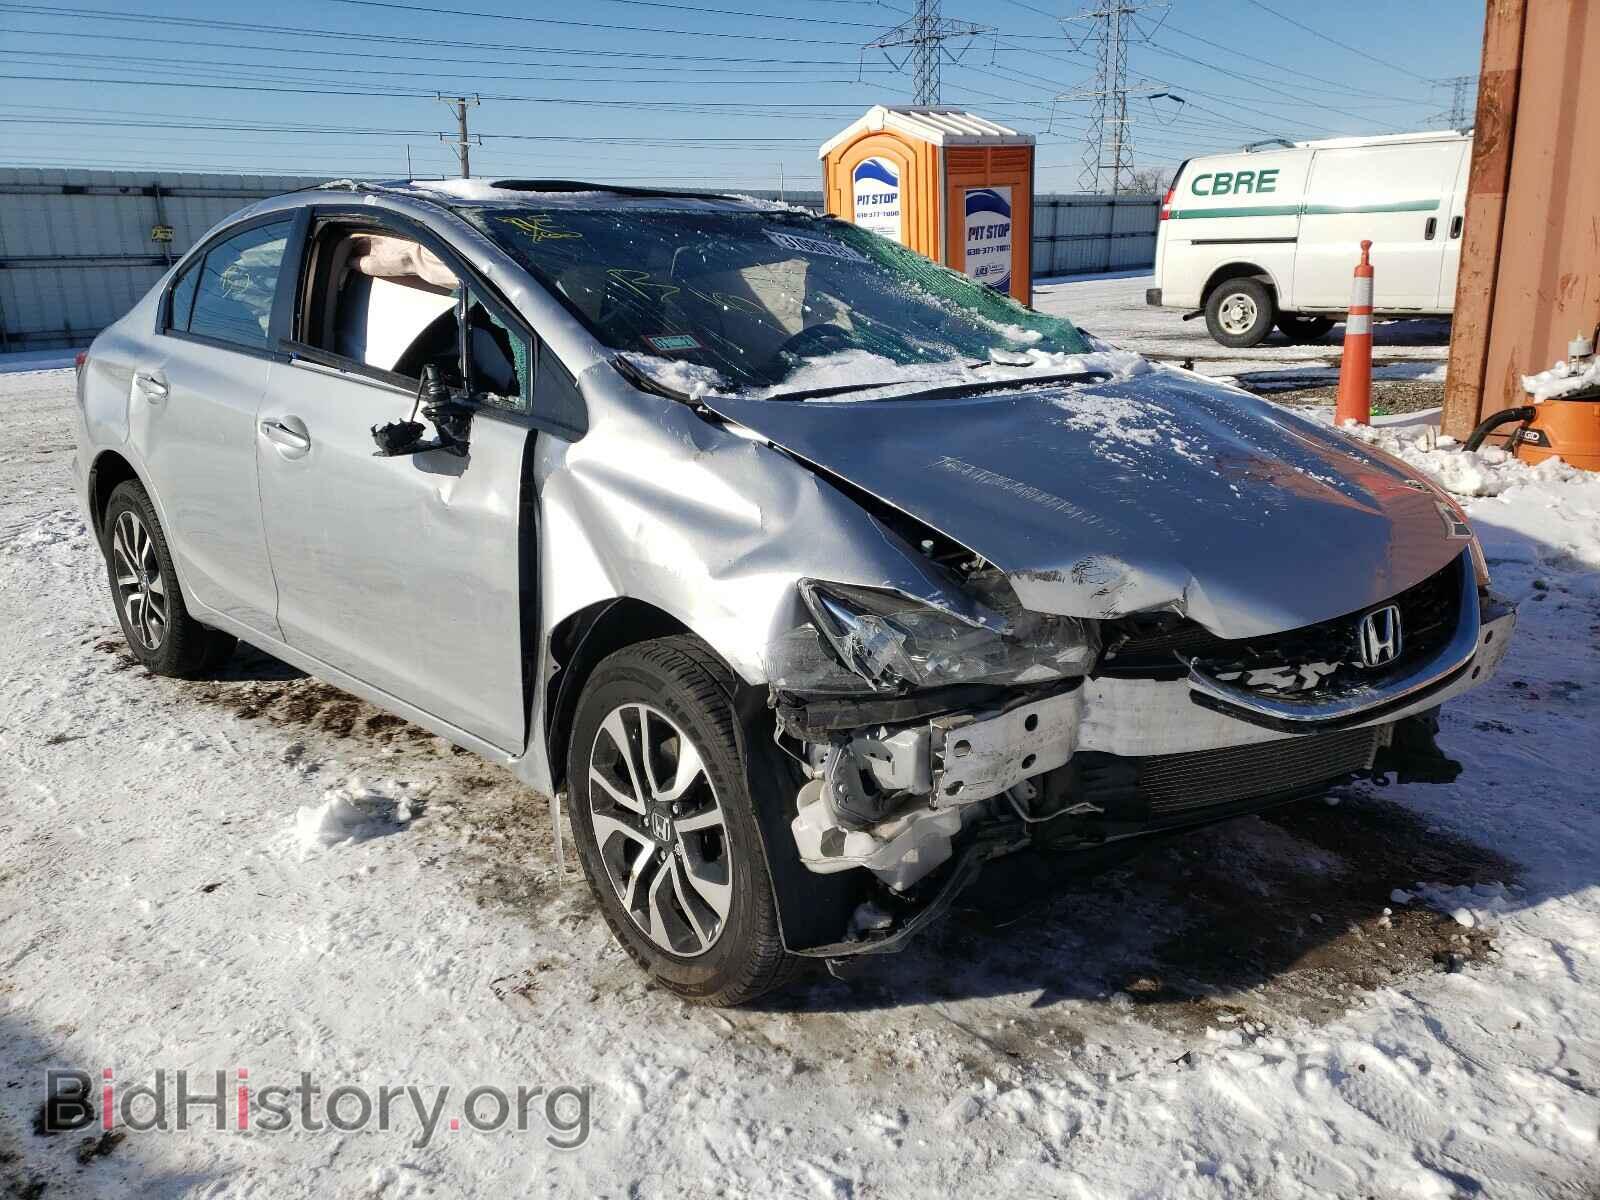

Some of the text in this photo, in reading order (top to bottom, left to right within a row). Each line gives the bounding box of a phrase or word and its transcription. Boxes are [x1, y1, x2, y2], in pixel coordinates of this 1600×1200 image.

[1191, 168, 1281, 196] CBRE
[857, 192, 898, 206] PIT STOP
[967, 222, 1010, 241] PIT STOP
